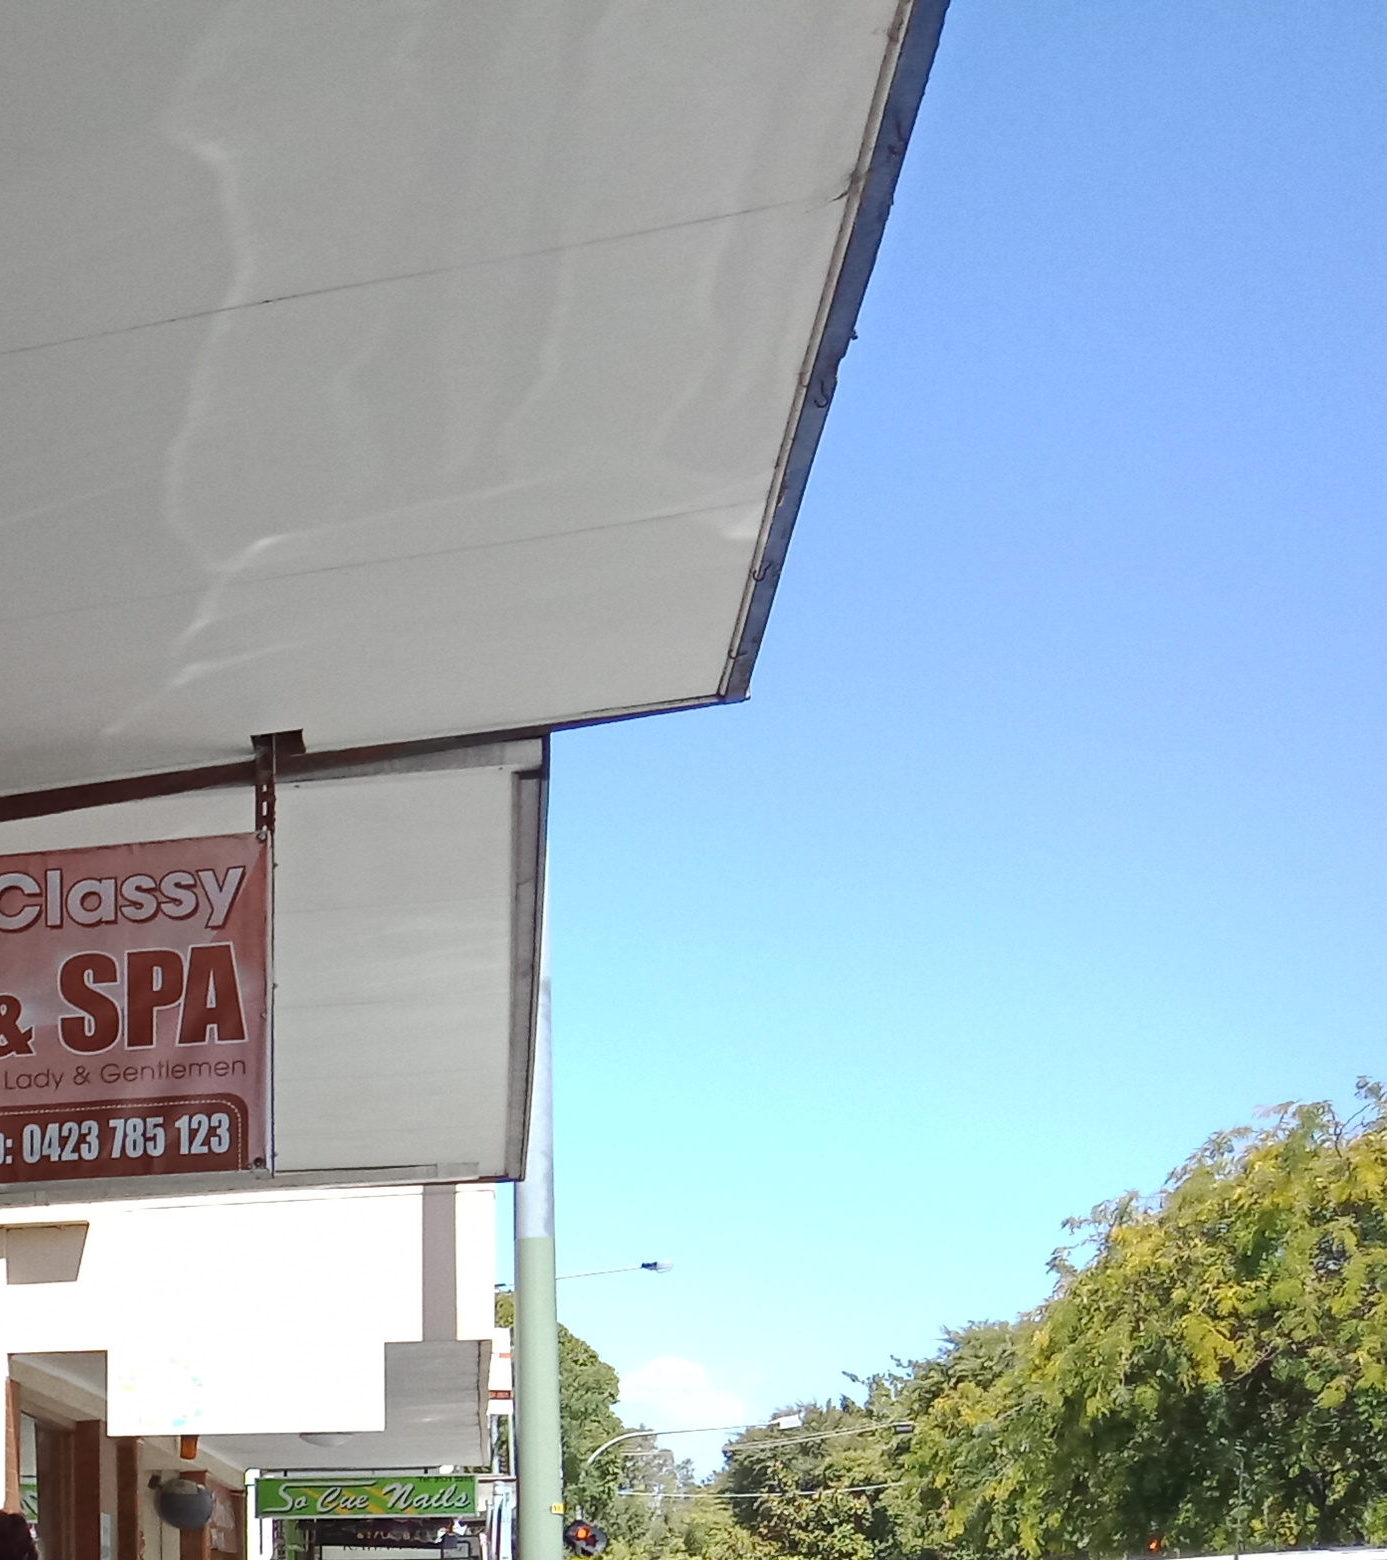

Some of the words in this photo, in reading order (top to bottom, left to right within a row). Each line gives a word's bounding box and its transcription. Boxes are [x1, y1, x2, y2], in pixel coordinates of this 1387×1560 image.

[57, 941, 249, 1055] SPA
[3, 1067, 65, 1093] Lady
[73, 1065, 91, 1086] &
[100, 1057, 247, 1085] Gentlemen
[22, 1120, 98, 1164] 0423
[108, 1116, 166, 1159] 785
[174, 1112, 232, 1156] 123
[316, 1487, 370, 1513] Cue
[382, 1482, 471, 1510] Nails
